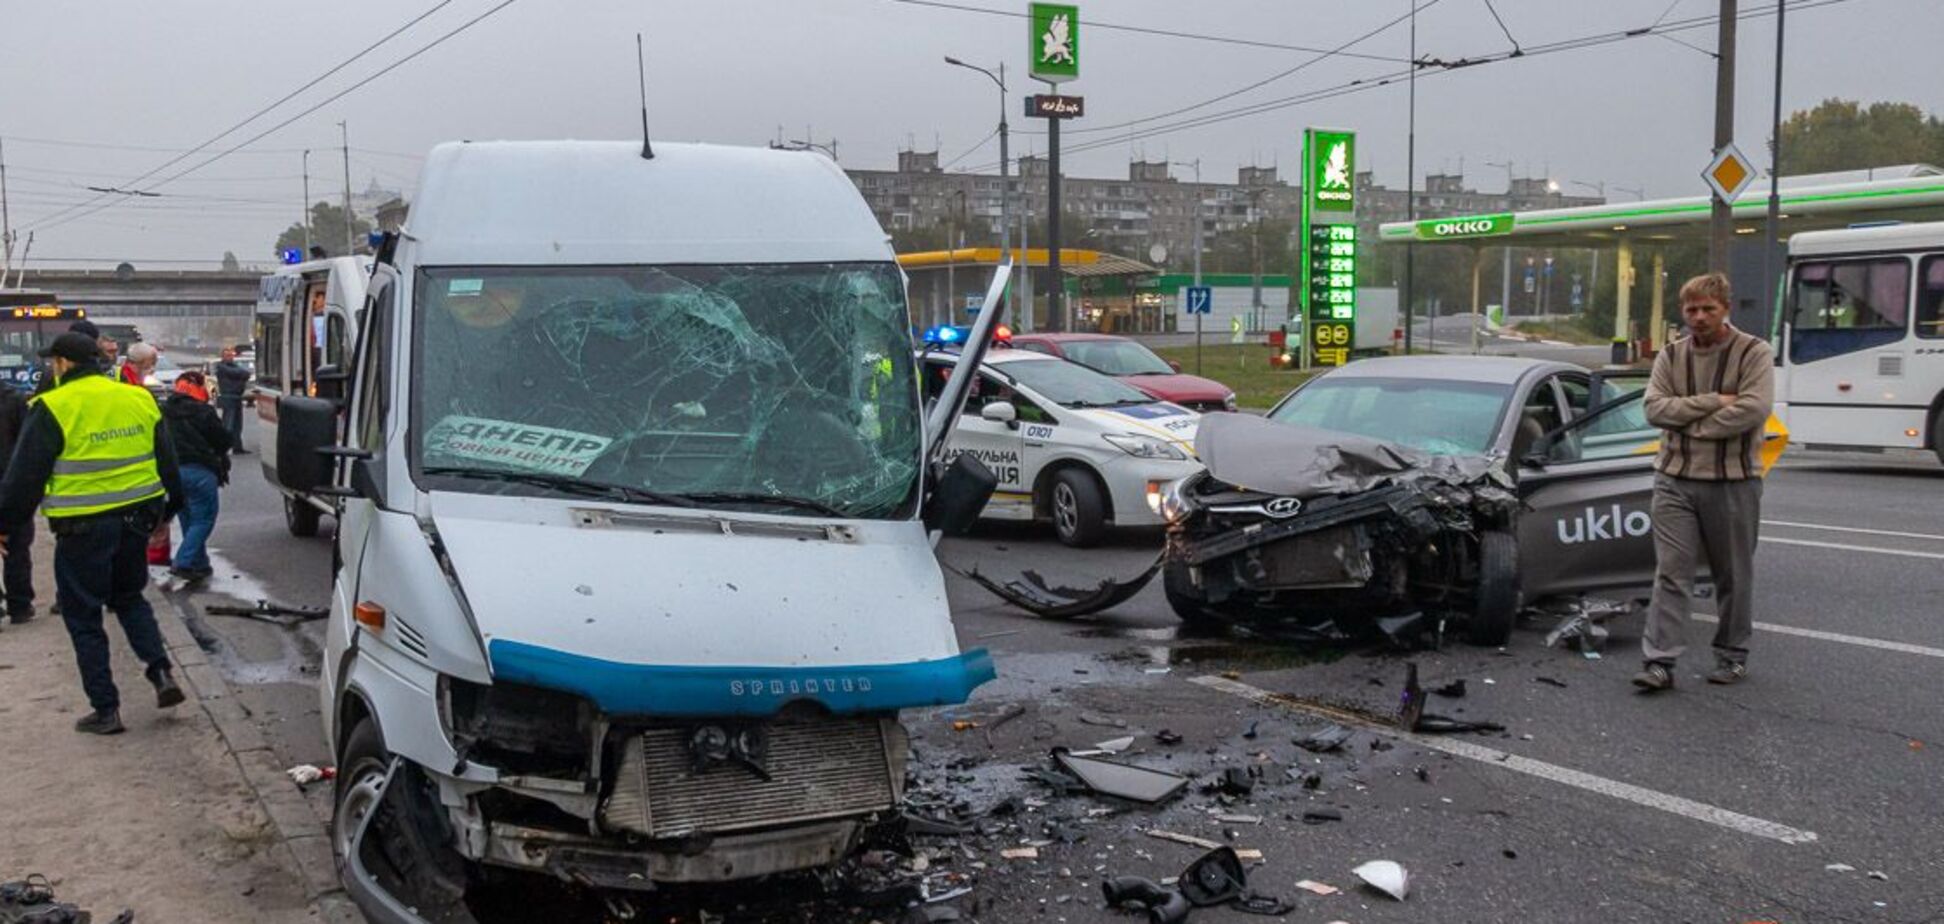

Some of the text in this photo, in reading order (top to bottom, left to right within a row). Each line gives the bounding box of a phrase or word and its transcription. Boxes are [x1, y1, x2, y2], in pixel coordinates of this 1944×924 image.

[1434, 219, 1493, 236] OKKO
[1026, 425, 1054, 440] 0101
[730, 677, 872, 696] SPRINTER
